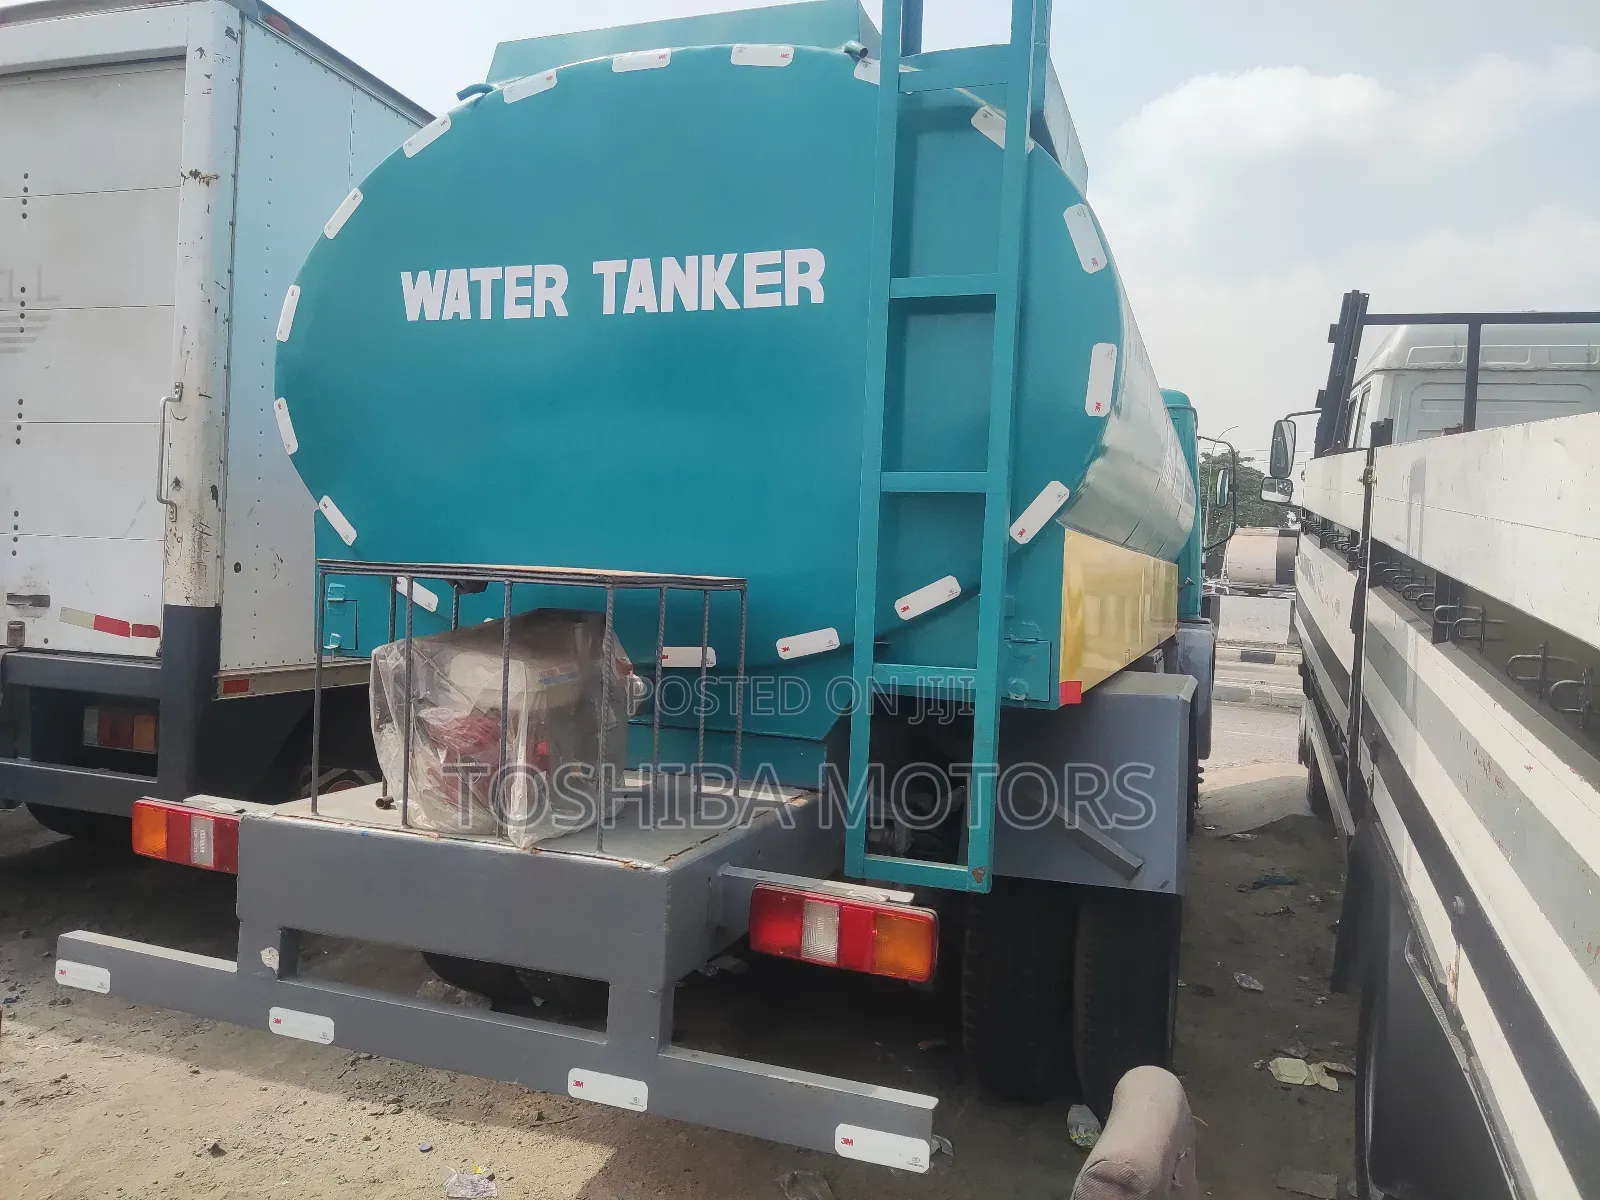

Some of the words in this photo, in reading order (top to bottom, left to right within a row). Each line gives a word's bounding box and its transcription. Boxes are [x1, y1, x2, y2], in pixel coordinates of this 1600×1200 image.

[401, 264, 568, 321] WATER
[593, 248, 826, 315] TANKER
[900, 605, 910, 613] 3M
[272, 1017, 282, 1025] 3M
[572, 1079, 584, 1088] 3M
[840, 1137, 854, 1146] 3M
